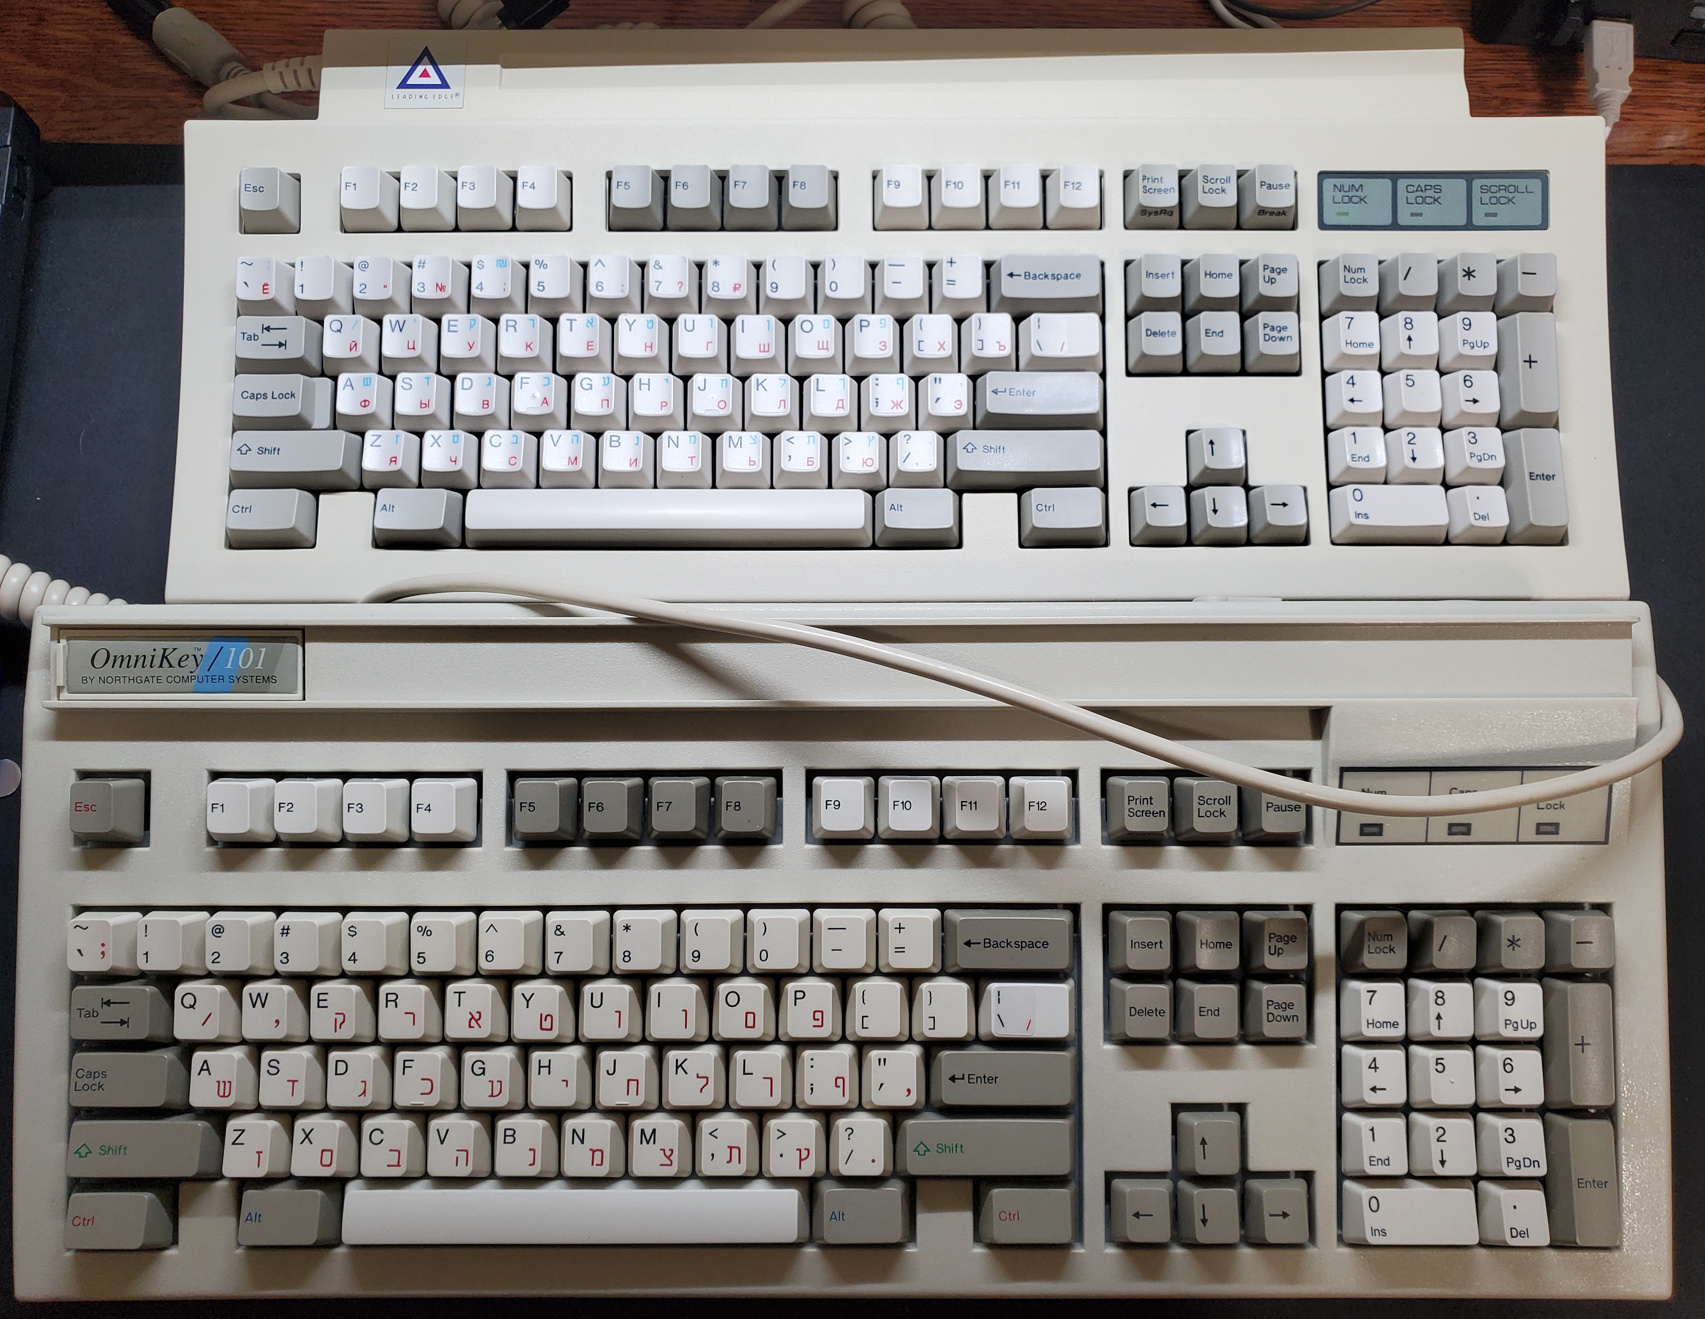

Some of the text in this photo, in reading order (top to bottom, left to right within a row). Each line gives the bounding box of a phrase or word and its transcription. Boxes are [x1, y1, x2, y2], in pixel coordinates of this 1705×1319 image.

[1142, 175, 1163, 183] Print
[1202, 175, 1230, 184] Scroll
[245, 184, 264, 193] Esc
[345, 182, 356, 191] F1
[404, 182, 418, 191] F2
[461, 181, 475, 190] F3
[522, 181, 536, 190] F4
[617, 181, 630, 190] F5
[675, 181, 688, 190] F6
[734, 181, 747, 189] F7
[793, 181, 806, 190] F8
[887, 180, 900, 189] F9
[945, 180, 963, 190] F10
[1004, 180, 1020, 189] F11
[1064, 181, 1081, 190] F12
[1142, 185, 1175, 194] Screen
[1202, 185, 1226, 194] Lock
[1260, 181, 1290, 190] Pause
[1333, 184, 1363, 193] NUM
[1406, 184, 1442, 193] CAPS
[1480, 184, 1534, 194] SCROLL
[1333, 195, 1367, 204] LOCK
[1406, 196, 1442, 205] LOCK
[1480, 196, 1515, 205] LOCK
[1146, 270, 1174, 279] Insert
[1204, 270, 1233, 279] Home
[1263, 264, 1287, 275] Page
[1344, 265, 1365, 274] Num
[1024, 271, 1081, 281] Backspace
[1263, 275, 1276, 285] Up
[1344, 275, 1368, 284] Lock
[330, 320, 343, 333] Q
[389, 320, 406, 332] W
[448, 319, 458, 333] E
[1263, 323, 1288, 333] Page
[241, 332, 259, 341] Tab
[1146, 328, 1176, 337] Delete
[1205, 329, 1223, 337] End
[1263, 333, 1292, 342] Down
[1345, 340, 1374, 348] Home
[1463, 339, 1489, 350] PgUp
[241, 391, 295, 401] Caps Lock
[1009, 388, 1036, 397] Enter
[257, 447, 280, 455] Shift
[983, 445, 1005, 453] Shift
[1351, 454, 1370, 462] End
[1470, 452, 1496, 463] PgDn
[1529, 472, 1556, 481] Enter
[232, 505, 252, 513] Ctrl
[380, 504, 395, 512] Alt
[889, 503, 902, 511] Alt
[1036, 503, 1054, 512] Ctrl
[1355, 511, 1369, 519] Ins
[1473, 512, 1489, 521] Del
[82, 675, 277, 684] BY NORTHGATE COMPUTER SYSTEMS
[826, 800, 840, 809] F9
[893, 800, 911, 810] F10
[961, 801, 977, 810] F11
[1128, 796, 1153, 805] Print
[1198, 796, 1231, 805] Scroll
[75, 802, 97, 812] Esc
[212, 803, 224, 813] F1
[279, 802, 294, 812] F2
[348, 803, 363, 813] F3
[417, 804, 431, 813] F4
[520, 802, 535, 812] F5
[588, 802, 604, 812] F6
[657, 802, 672, 811] F7
[726, 801, 741, 811] F8
[1029, 801, 1047, 811] F12
[1266, 802, 1302, 812] Pause
[1536, 802, 1566, 810] Lock
[1128, 808, 1165, 817] Screen
[1198, 808, 1226, 818] Lock
[1269, 933, 1297, 945] Page
[1368, 932, 1393, 942] Num
[984, 938, 1049, 951] Backspace
[1131, 939, 1163, 949] Insert
[1200, 939, 1233, 949] Home
[1368, 944, 1396, 954] Lock
[1269, 945, 1284, 957] Up
[181, 992, 196, 1009] Q
[249, 993, 268, 1008] W
[317, 993, 328, 1008] E
[385, 993, 398, 1008] R
[454, 991, 466, 1007] T
[521, 993, 534, 1008] Y
[591, 992, 603, 1008] U
[725, 991, 740, 1007] O
[794, 990, 806, 1006] P
[1366, 990, 1377, 1005] 7
[1435, 990, 1445, 1006] 8
[1504, 990, 1515, 1006] 9
[1199, 1006, 1220, 1016] End
[1267, 1000, 1294, 1012] Page
[76, 1008, 99, 1018] Tab
[1129, 1007, 1165, 1017] Delete
[1267, 1012, 1299, 1022] Down
[468, 1011, 481, 1028] א
[1367, 1019, 1399, 1029] Home
[1505, 1019, 1537, 1031] PgUp
[198, 1060, 211, 1076] A
[267, 1059, 280, 1076] S
[335, 1060, 348, 1076] D
[402, 1059, 414, 1075] F
[471, 1060, 485, 1076] G
[538, 1059, 551, 1075] H
[606, 1059, 616, 1076] J
[675, 1058, 688, 1075] K
[743, 1059, 753, 1075] L
[1368, 1057, 1379, 1073] 4
[1435, 1058, 1445, 1073] 5
[1503, 1057, 1514, 1073] 6
[76, 1068, 107, 1081] Caps
[968, 1074, 998, 1084] Enter
[74, 1081, 104, 1091] Lock
[216, 1080, 232, 1098] ש
[231, 1129, 245, 1145] Z
[300, 1128, 314, 1144] X
[369, 1128, 384, 1145] C
[437, 1129, 449, 1145] V
[503, 1128, 516, 1144] B
[572, 1128, 585, 1145] N
[640, 1128, 656, 1145] M
[1369, 1127, 1375, 1142] 1
[1436, 1126, 1446, 1142] 2
[1504, 1127, 1516, 1144] 3
[99, 1145, 127, 1156] Shift
[936, 1143, 964, 1154] Shift
[1369, 1156, 1390, 1166] End
[1506, 1157, 1540, 1170] PgDn
[1577, 1178, 1608, 1188] Enter
[1369, 1196, 1379, 1213] 0
[245, 1212, 262, 1223] Alt
[829, 1211, 845, 1221] Alt
[999, 1211, 1019, 1221] Ctrl
[72, 1216, 94, 1227] Ctrl
[1371, 1226, 1387, 1237] Ins
[1510, 1227, 1529, 1238] Del
